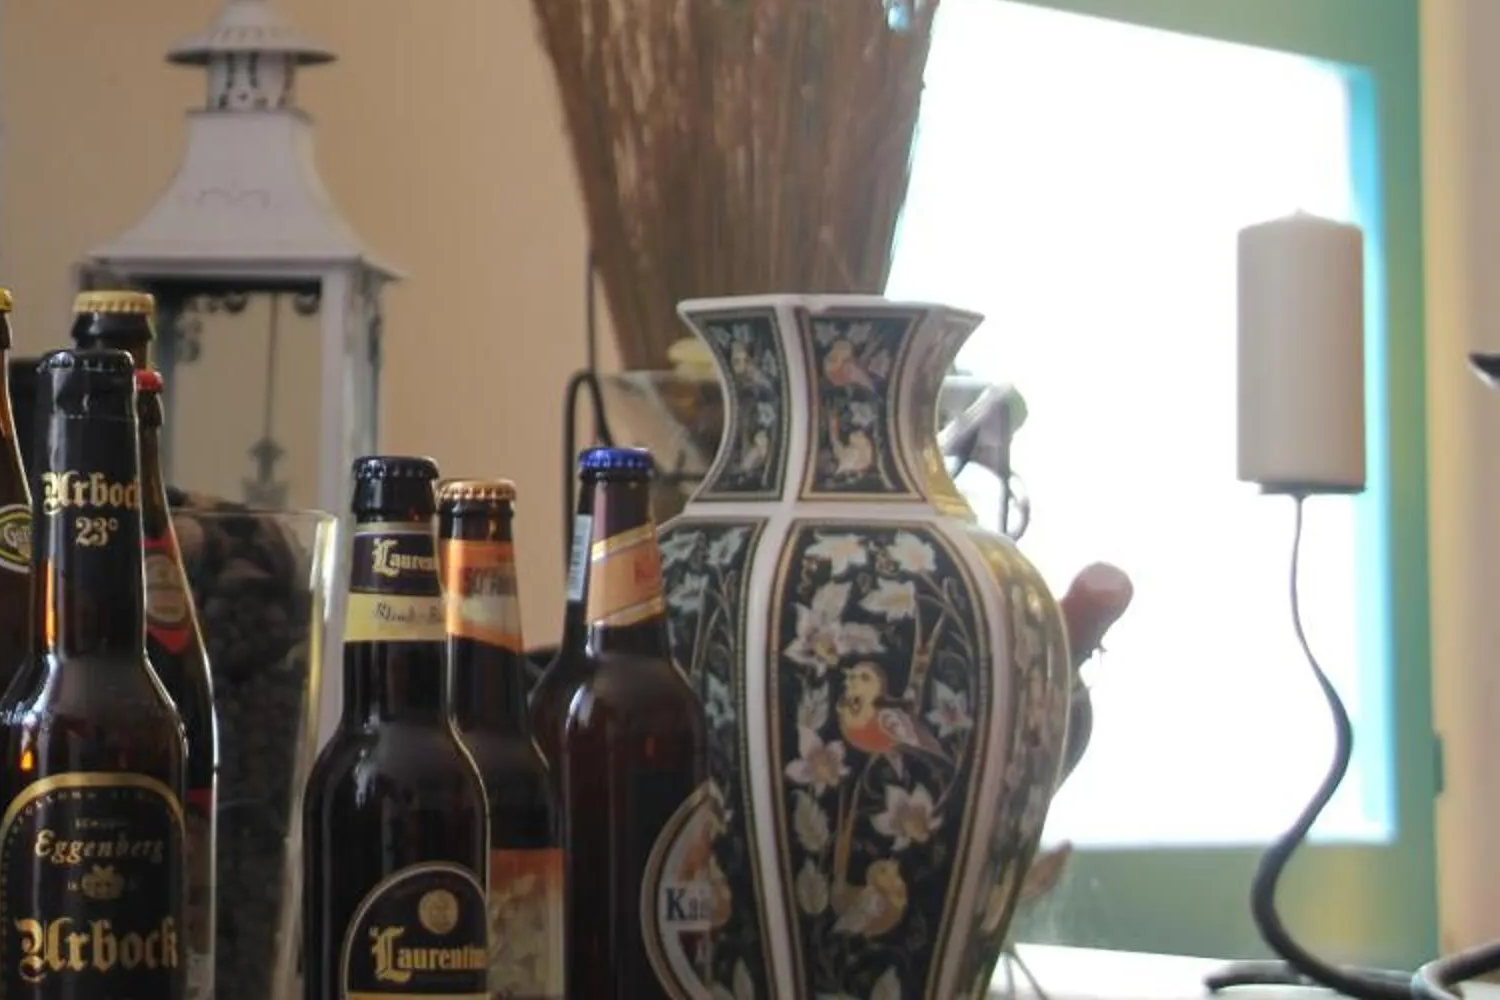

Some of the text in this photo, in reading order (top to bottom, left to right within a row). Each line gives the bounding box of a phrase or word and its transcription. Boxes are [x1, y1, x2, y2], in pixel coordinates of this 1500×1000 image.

[372, 537, 437, 578] Lauren
[35, 828, 166, 864] Eggenberg
[14, 916, 179, 984] Urbock
